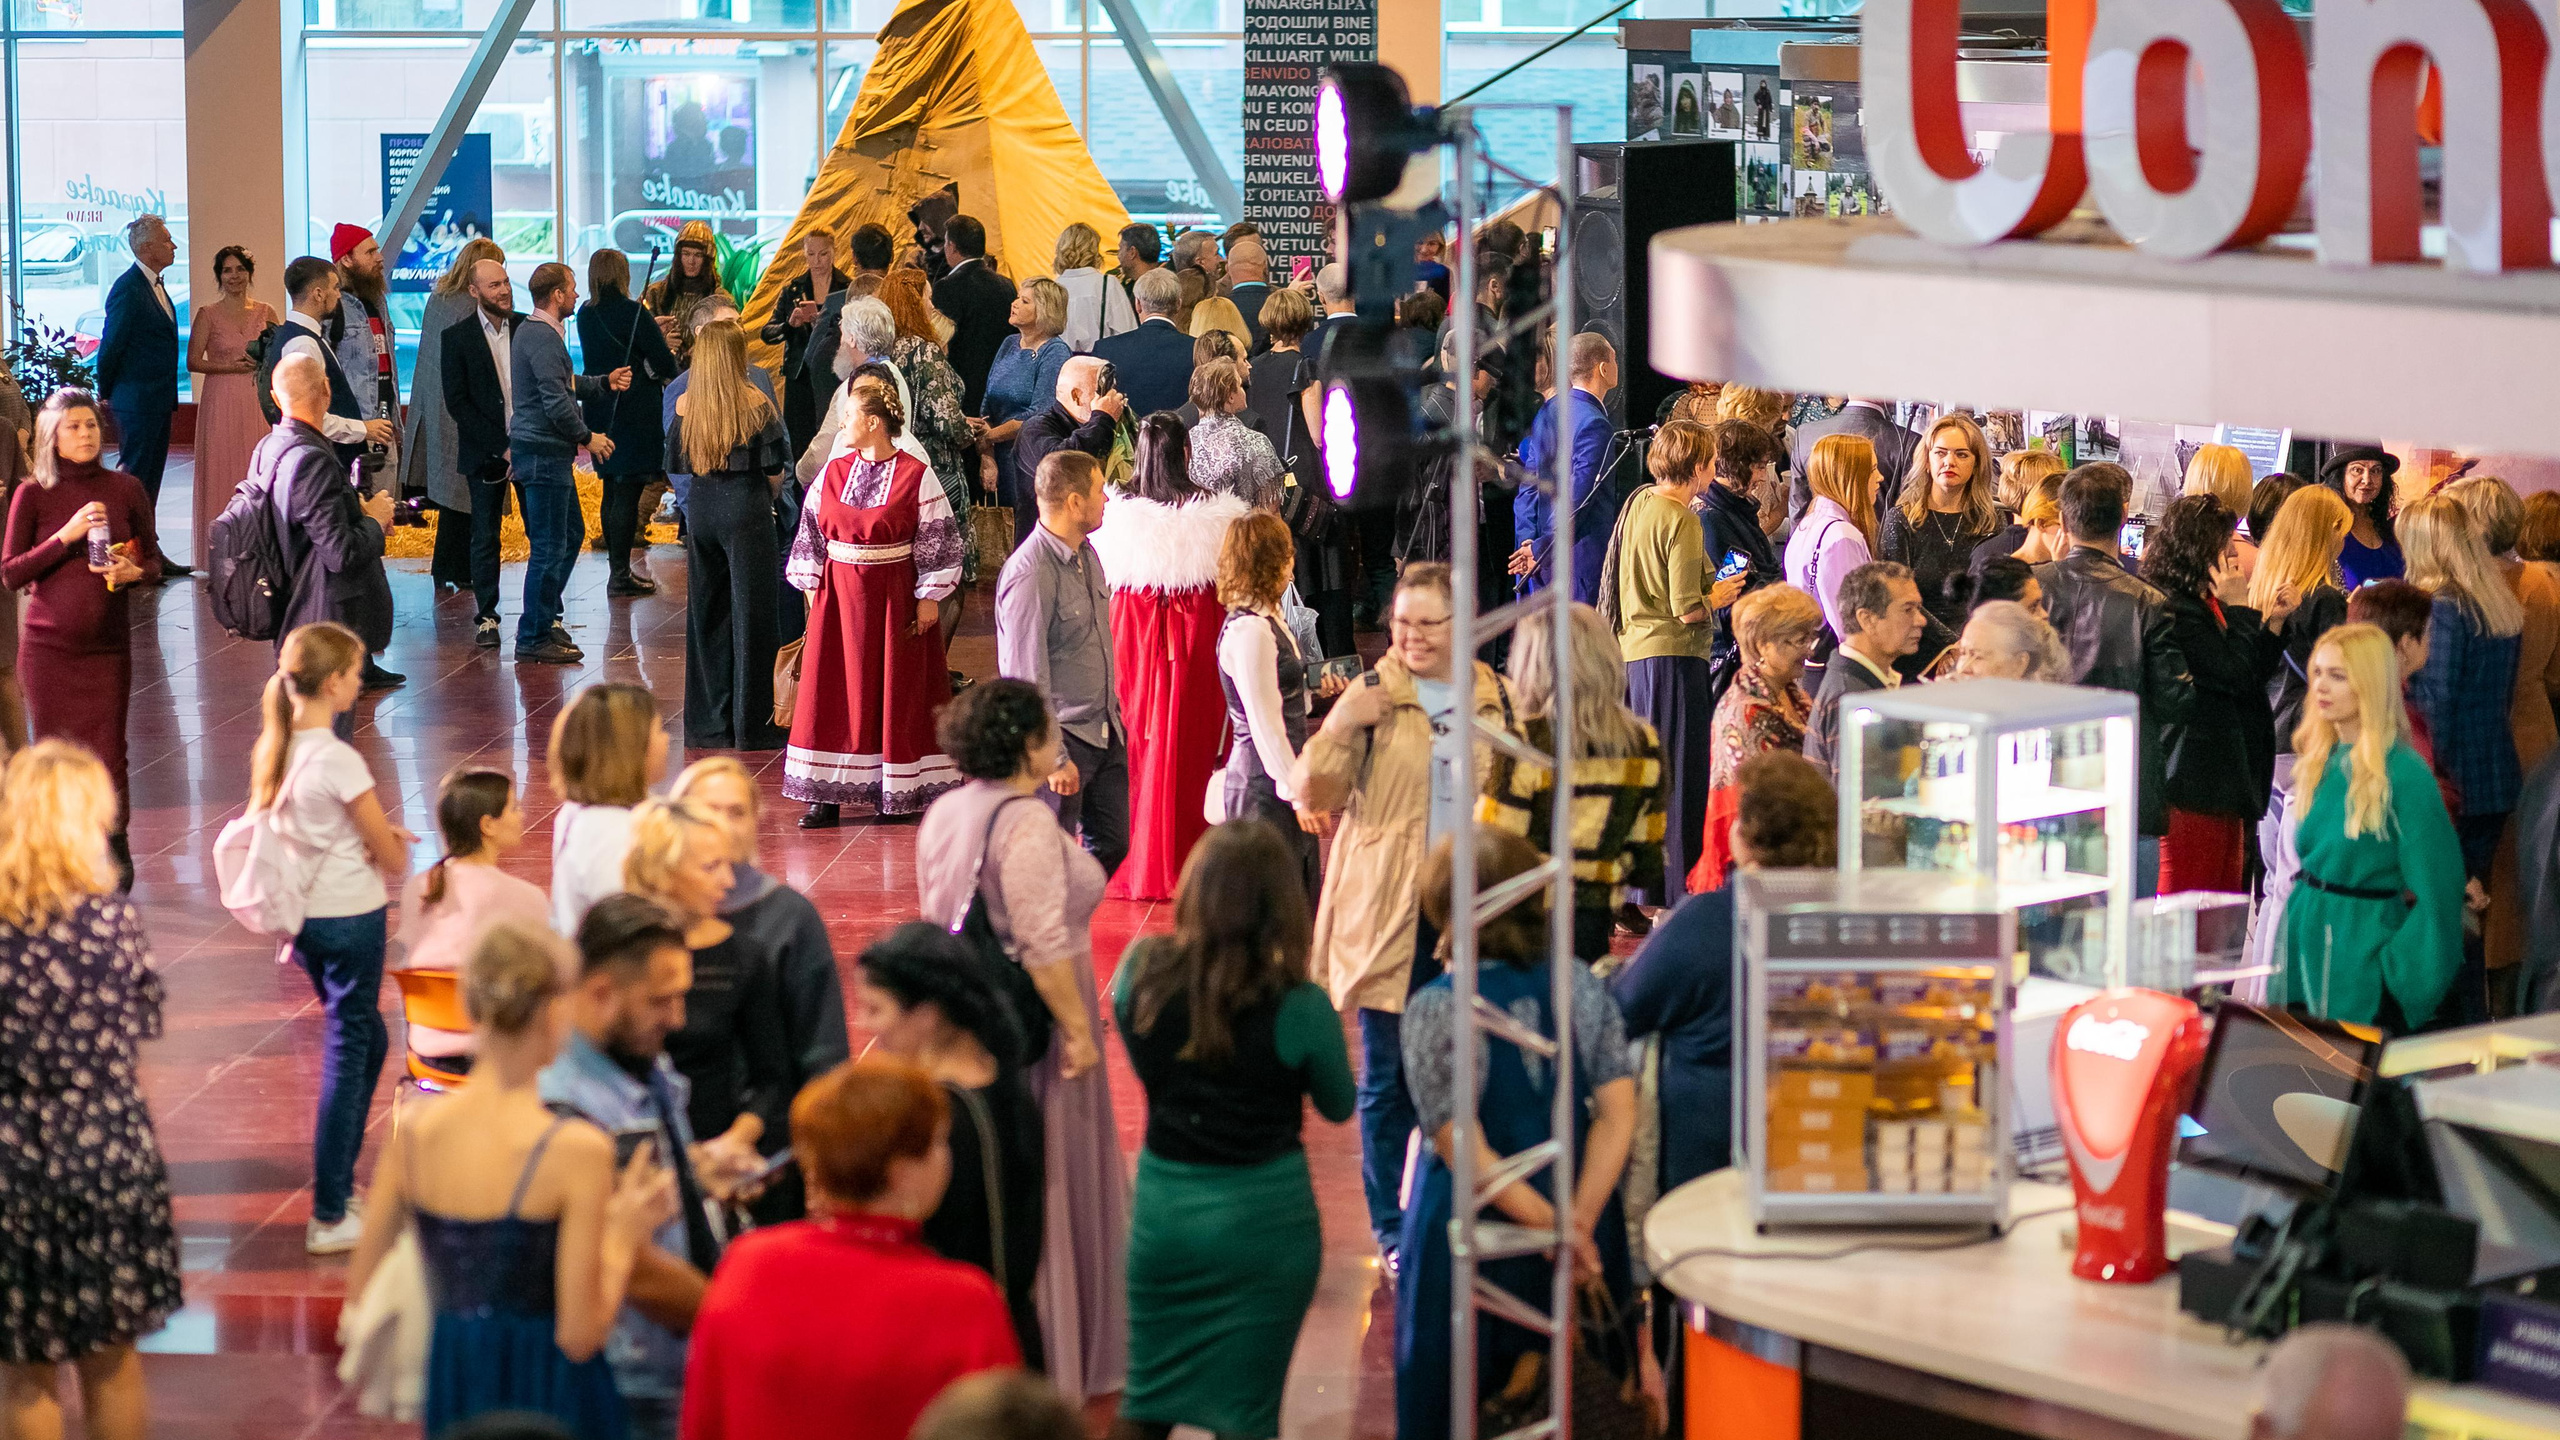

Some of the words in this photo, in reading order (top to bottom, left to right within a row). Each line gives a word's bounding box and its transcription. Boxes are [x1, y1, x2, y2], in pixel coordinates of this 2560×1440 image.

[1333, 16, 1371, 29] BINE
[1267, 102, 1277, 115] E
[1264, 119, 1309, 132] CEUD
[1244, 206, 1310, 219] BENVIDO
[1249, 222, 1324, 235] NVENUE
